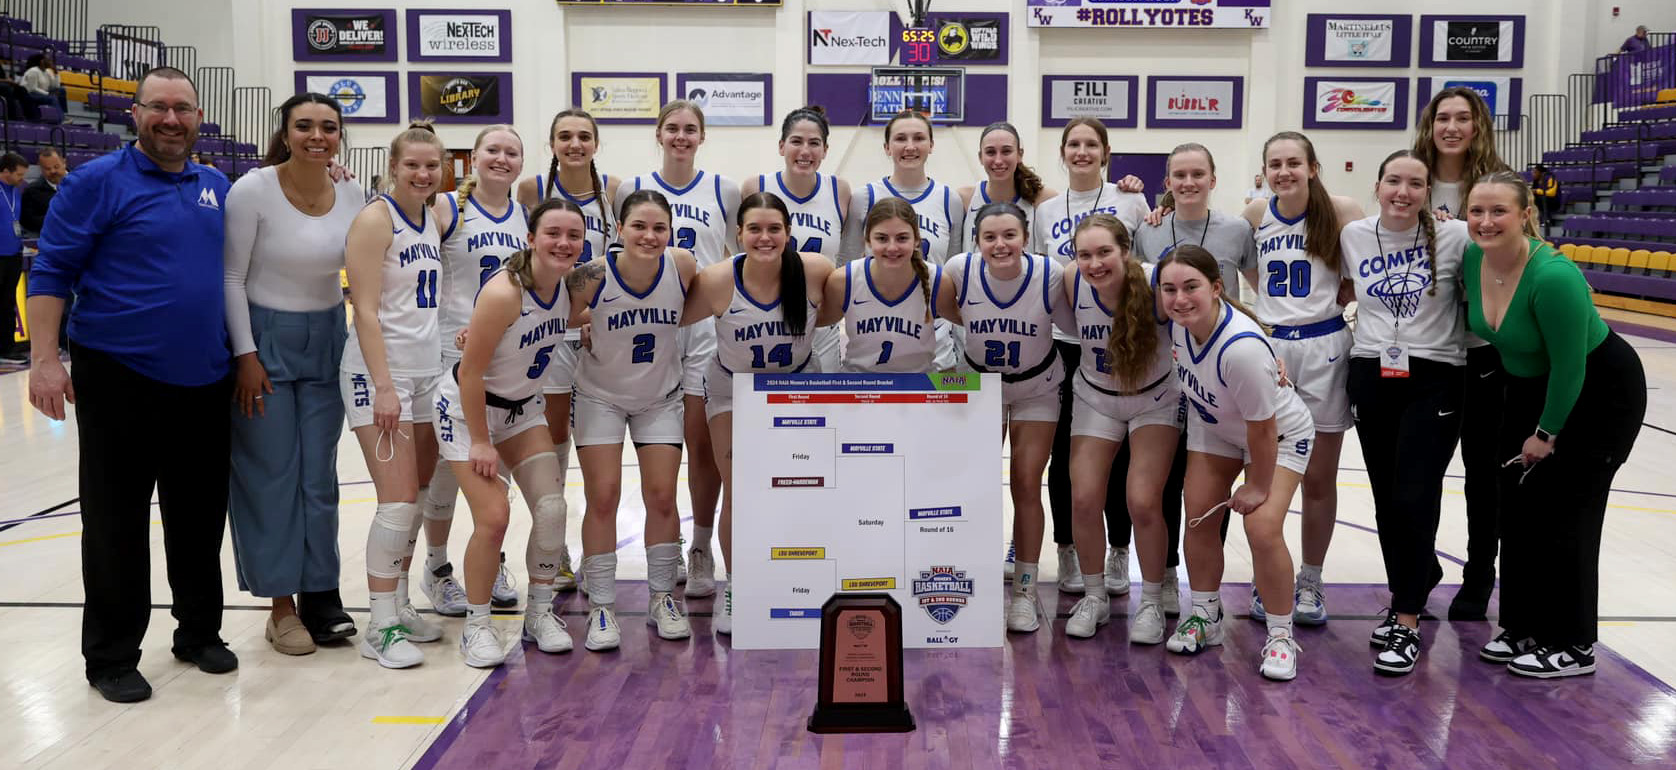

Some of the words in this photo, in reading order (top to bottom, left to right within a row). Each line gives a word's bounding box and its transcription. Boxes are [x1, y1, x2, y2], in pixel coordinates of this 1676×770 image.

[352, 20, 368, 30] WE
[339, 30, 384, 41] DELIVER!
[831, 36, 886, 47] Nex-Tech
[903, 30, 935, 42] 65:25
[429, 38, 495, 50] wireless
[970, 41, 997, 49] WINGS
[908, 43, 930, 62] 30
[440, 88, 480, 104] LIBRARY
[712, 90, 762, 100] Advantage
[1074, 82, 1107, 97] FILI
[1267, 260, 1312, 297] 20
[416, 269, 438, 308] 11
[608, 308, 677, 331] MAYVILLE
[857, 316, 922, 340] MAYVILLE
[970, 319, 1038, 337] MAYVILLE
[632, 333, 656, 364] 2
[750, 343, 793, 368] 14
[876, 341, 893, 365] 1
[984, 340, 1021, 368] 21
[526, 344, 556, 379] 5
[858, 519, 884, 527] Saturday
[858, 580, 889, 588] SHREVEPORT
[914, 581, 971, 593] BASKETBALL
